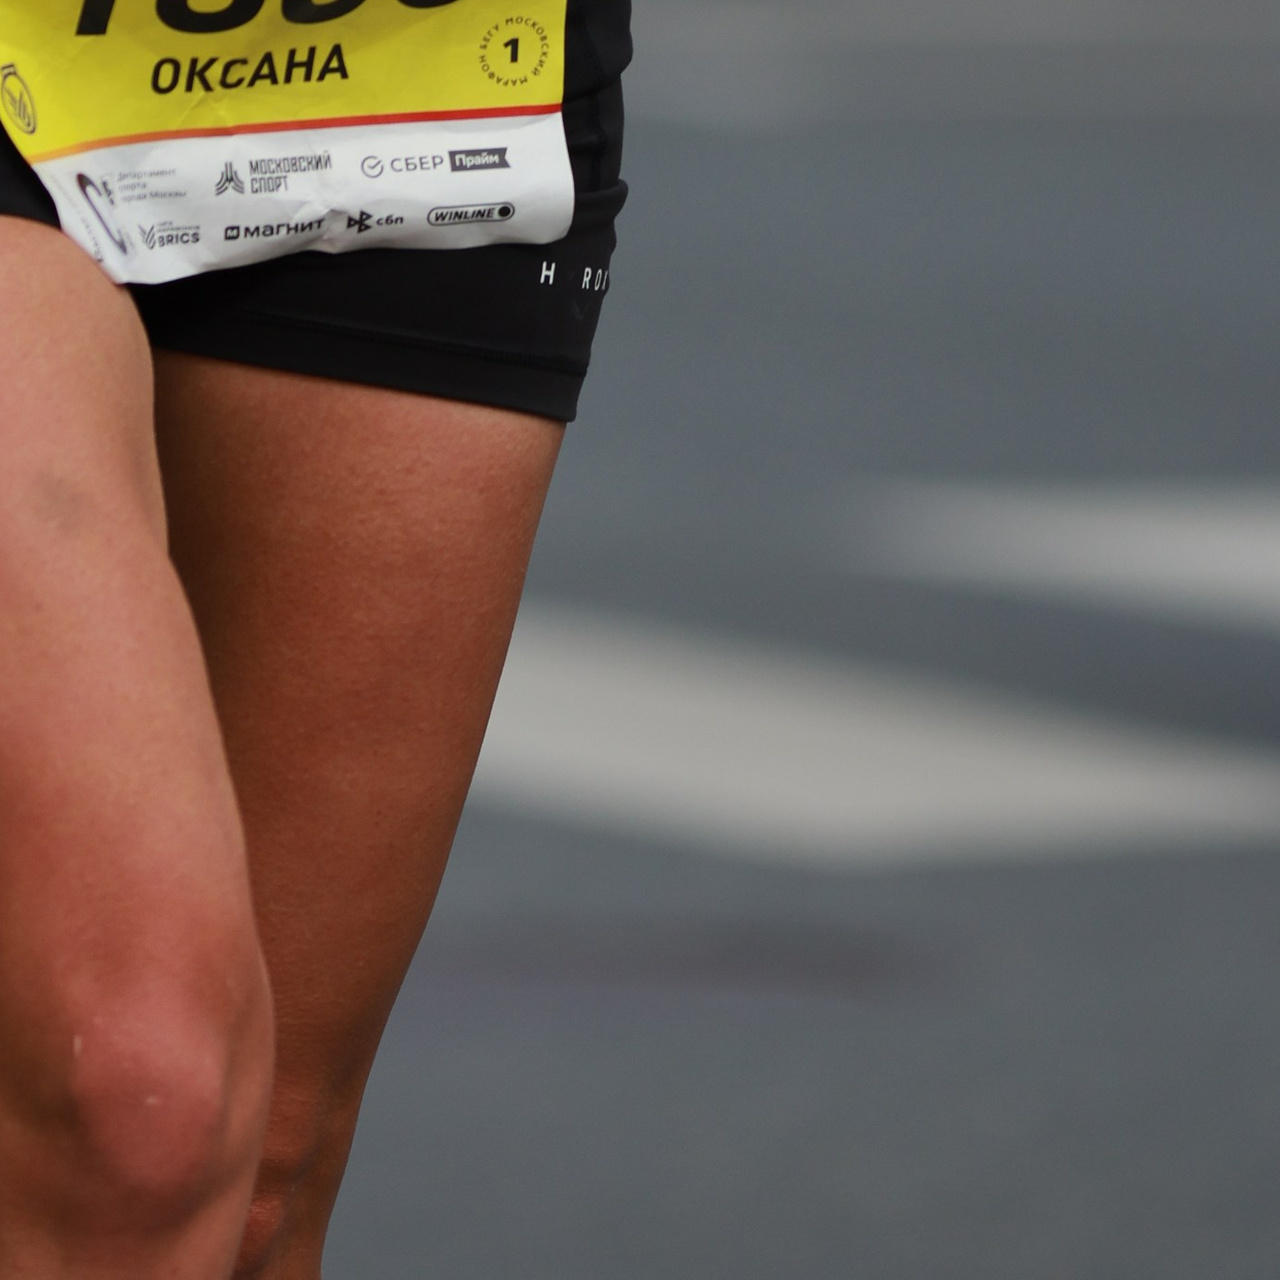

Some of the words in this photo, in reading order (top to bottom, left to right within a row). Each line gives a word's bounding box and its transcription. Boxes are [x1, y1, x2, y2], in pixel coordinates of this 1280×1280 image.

[503, 37, 519, 63] 1
[505, 16, 549, 76] МОСКОВСКИЙ
[151, 43, 349, 94] ОКСАНА
[479, 55, 528, 87] МАРАФОН
[249, 150, 332, 175] МОСКОВСКИЙ
[390, 155, 444, 173] СБЕР
[454, 153, 500, 168] Прайм
[250, 175, 288, 194] СПОРТ
[376, 214, 404, 226] сбп
[433, 210, 496, 223] WINLINE
[158, 232, 200, 247] BRICS
